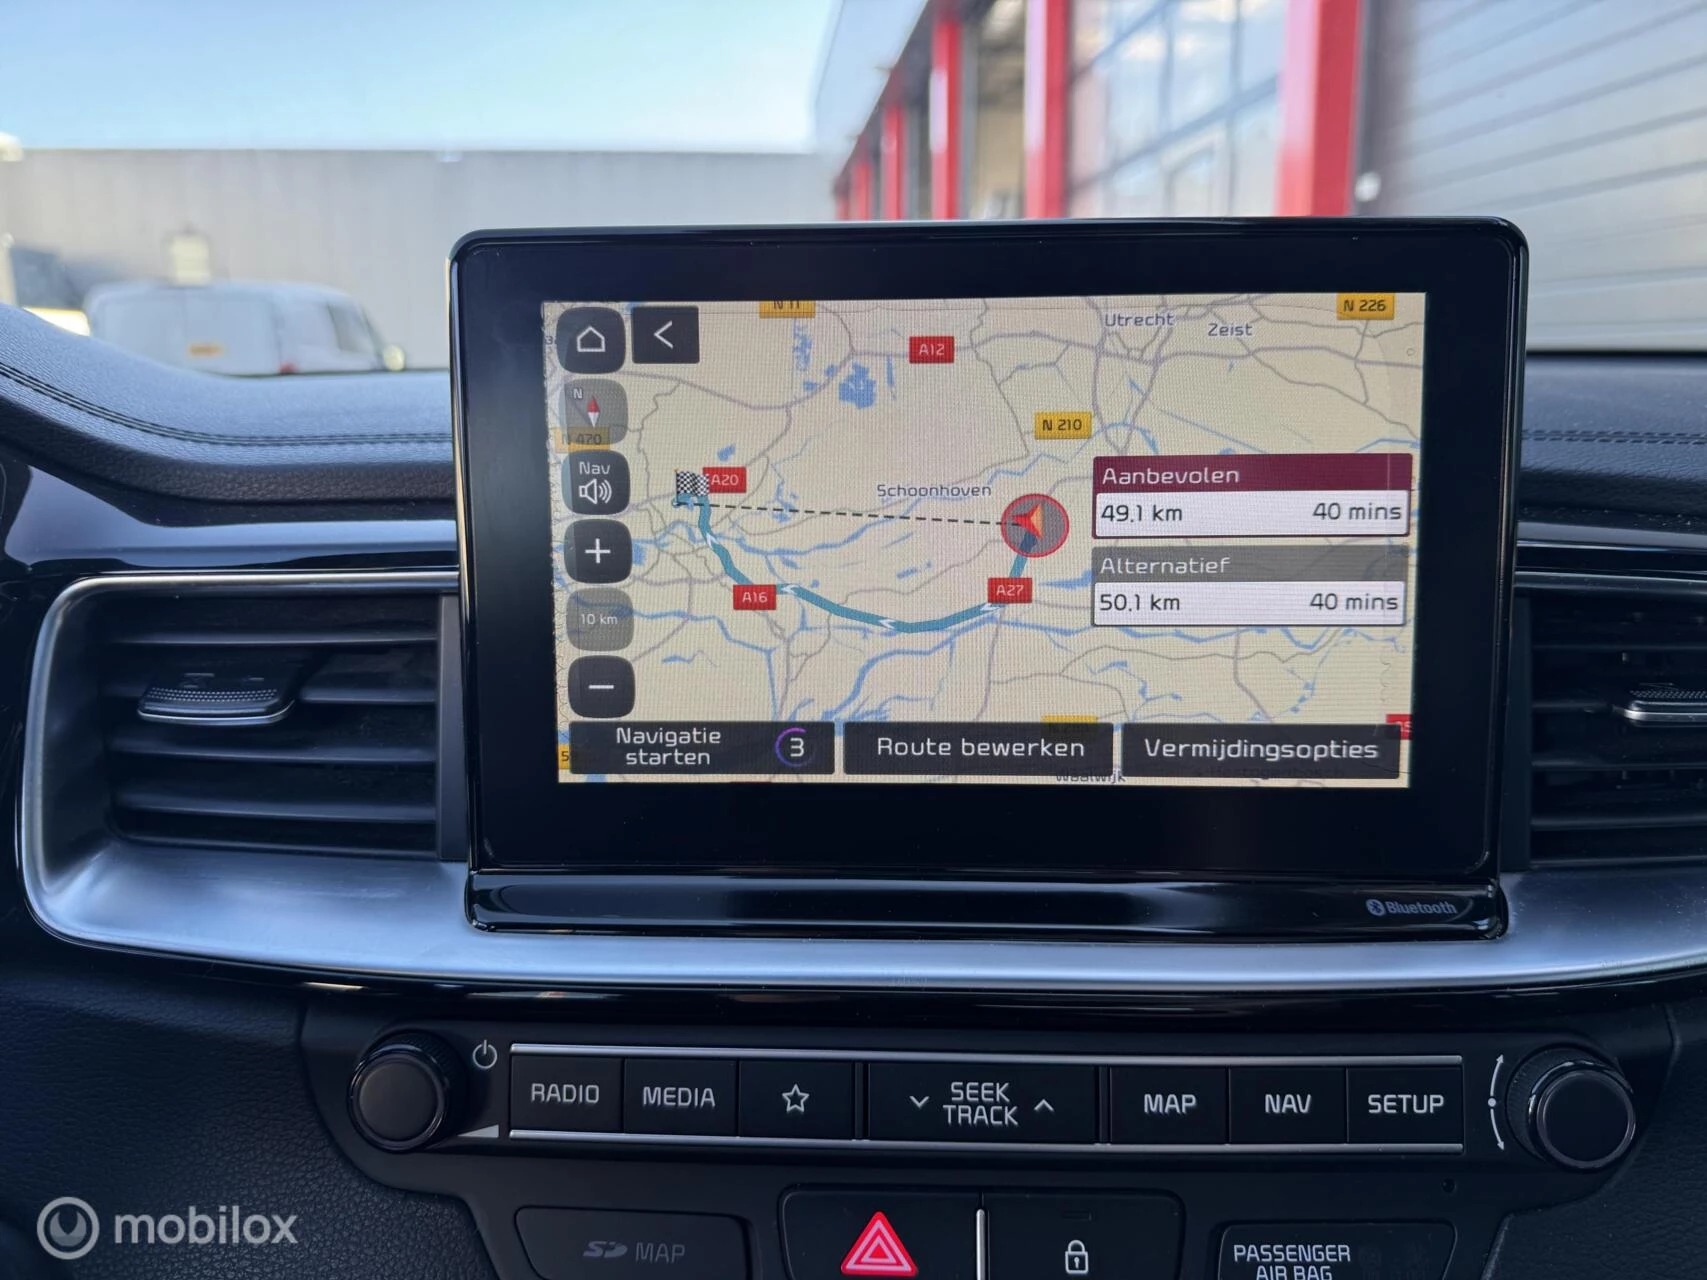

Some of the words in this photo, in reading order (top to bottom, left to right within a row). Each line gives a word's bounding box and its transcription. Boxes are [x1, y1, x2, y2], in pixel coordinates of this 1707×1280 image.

[1344, 301, 1354, 312] N
[1358, 300, 1386, 312] 226
[1104, 312, 1174, 327] Utrecht
[1207, 323, 1253, 336] Zeist
[918, 344, 945, 356] A12
[574, 388, 582, 399] N
[1042, 420, 1052, 431] N
[1058, 418, 1082, 431] 210
[579, 462, 610, 475] Nav
[1102, 466, 1240, 485] Aanbevolen
[710, 474, 738, 486] A20
[876, 484, 992, 498] Schoonhoven
[1152, 504, 1182, 522] km
[1312, 502, 1341, 520] 40
[1348, 502, 1402, 520] mins
[1100, 557, 1231, 574] Alternatief
[742, 592, 768, 604] A16
[996, 584, 1024, 596] A27
[1150, 594, 1180, 611] km
[1310, 592, 1338, 610] 40
[1345, 594, 1398, 610] mins
[580, 614, 596, 625] 10
[600, 614, 618, 625] km
[616, 727, 722, 747] Navigatie
[790, 738, 805, 758] 3
[877, 737, 952, 756] Route
[961, 738, 1084, 757] bewerken
[1144, 738, 1379, 762] Vermijdingsopties
[626, 748, 710, 765] starten
[1384, 901, 1458, 914] Bluetooth
[530, 1083, 600, 1104] RADIO
[642, 1086, 716, 1108] MEDIA
[950, 1082, 1010, 1102] SEEK
[1144, 1094, 1197, 1114] MAP
[1264, 1094, 1312, 1114] NAV
[1368, 1094, 1444, 1114] SETUP
[943, 1104, 1019, 1126] TRACK
[635, 1242, 686, 1264] MAP
[1234, 1244, 1352, 1262] PASSENGER
[1256, 1266, 1288, 1280] AIR
[1293, 1266, 1332, 1280] BAG
